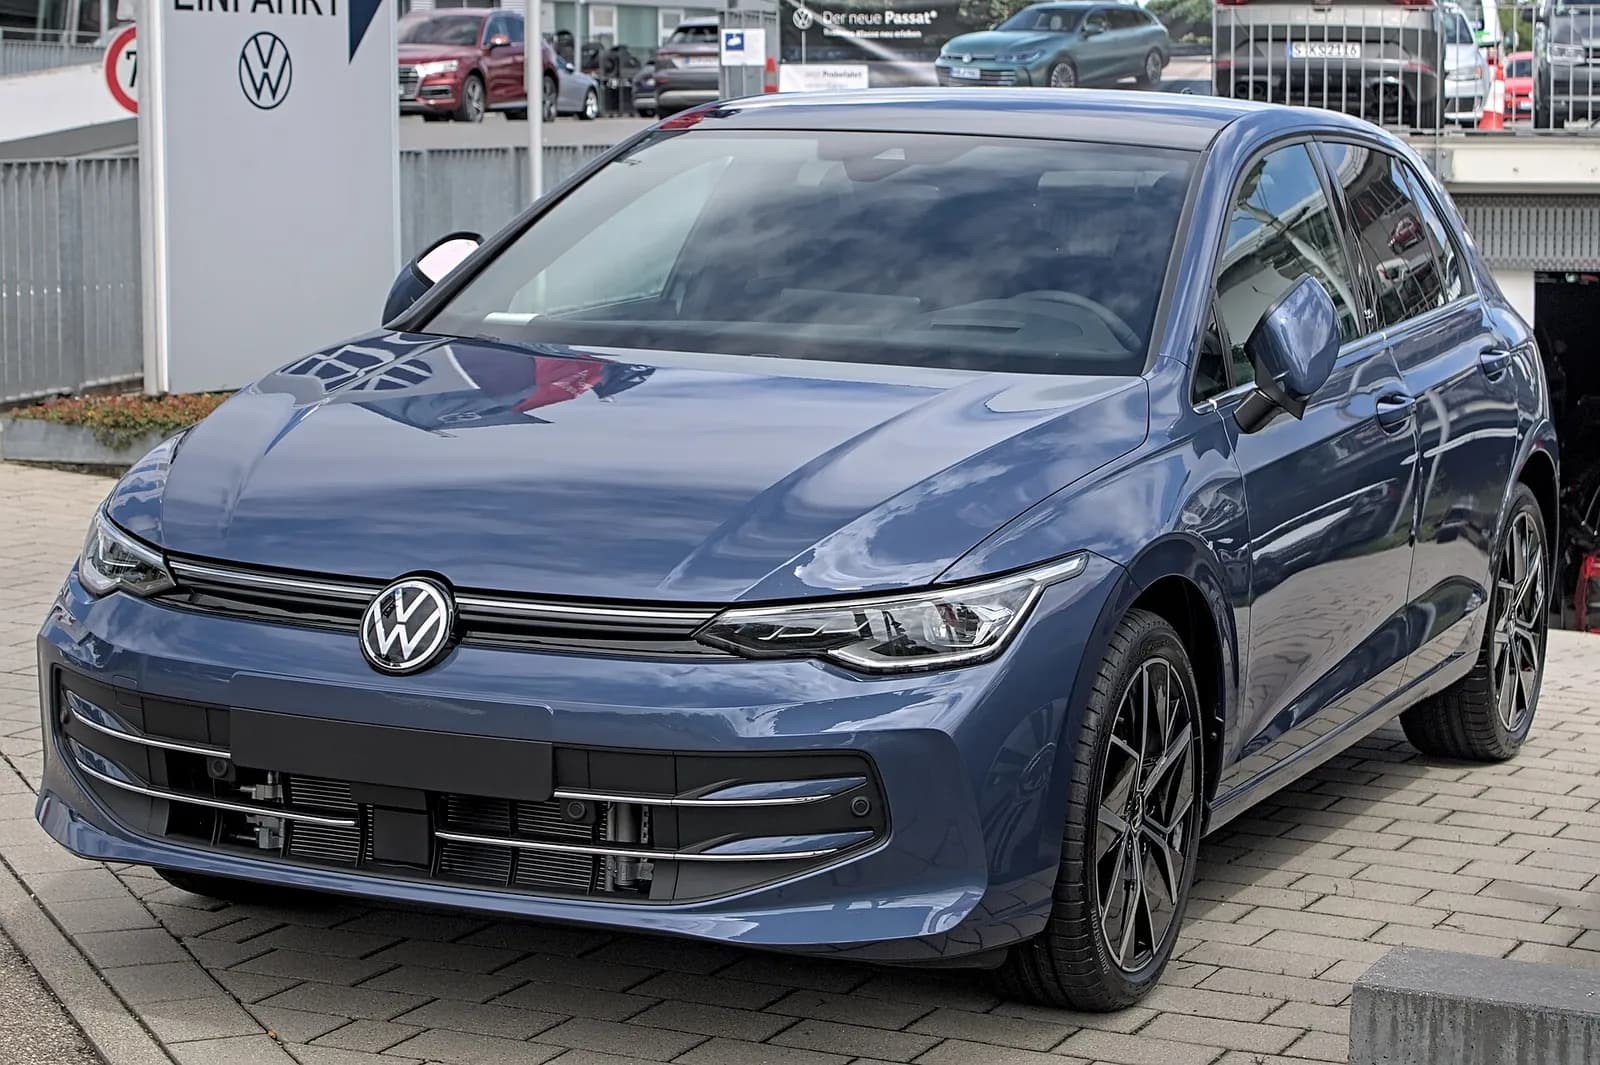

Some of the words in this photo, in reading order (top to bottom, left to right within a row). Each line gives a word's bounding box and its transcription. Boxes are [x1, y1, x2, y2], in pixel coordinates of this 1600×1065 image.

[823, 10, 845, 25] Der
[848, 13, 882, 25] neue
[368, 583, 444, 664] VW
